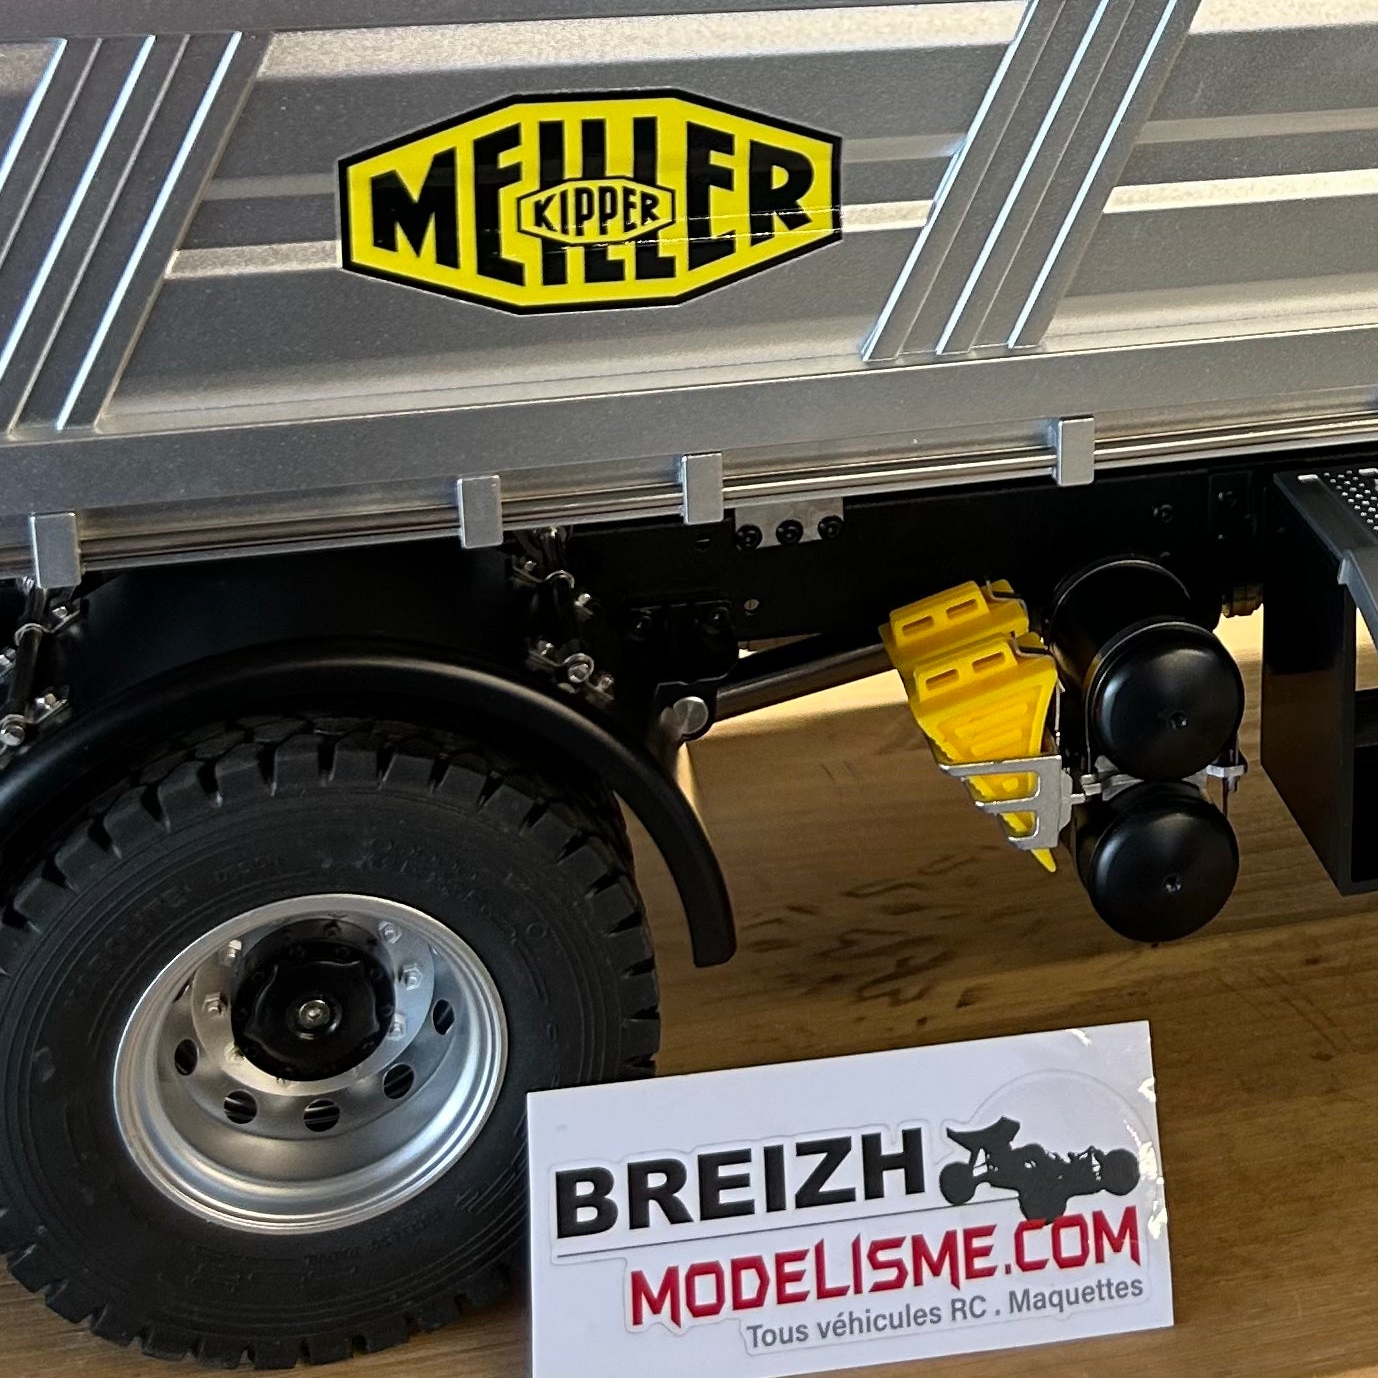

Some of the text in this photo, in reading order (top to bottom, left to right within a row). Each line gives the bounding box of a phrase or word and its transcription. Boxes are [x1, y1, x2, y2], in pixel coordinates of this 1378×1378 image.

[370, 116, 815, 286] MEILLER
[533, 186, 660, 235] KIPPER
[556, 1127, 925, 1239] BREIZH
[630, 1205, 1141, 1329] MODELISME.COM
[747, 1324, 809, 1349] Tous
[817, 1304, 942, 1339] véhicules
[950, 1295, 988, 1322] RC
[1008, 1275, 1144, 1314] Maquettes
